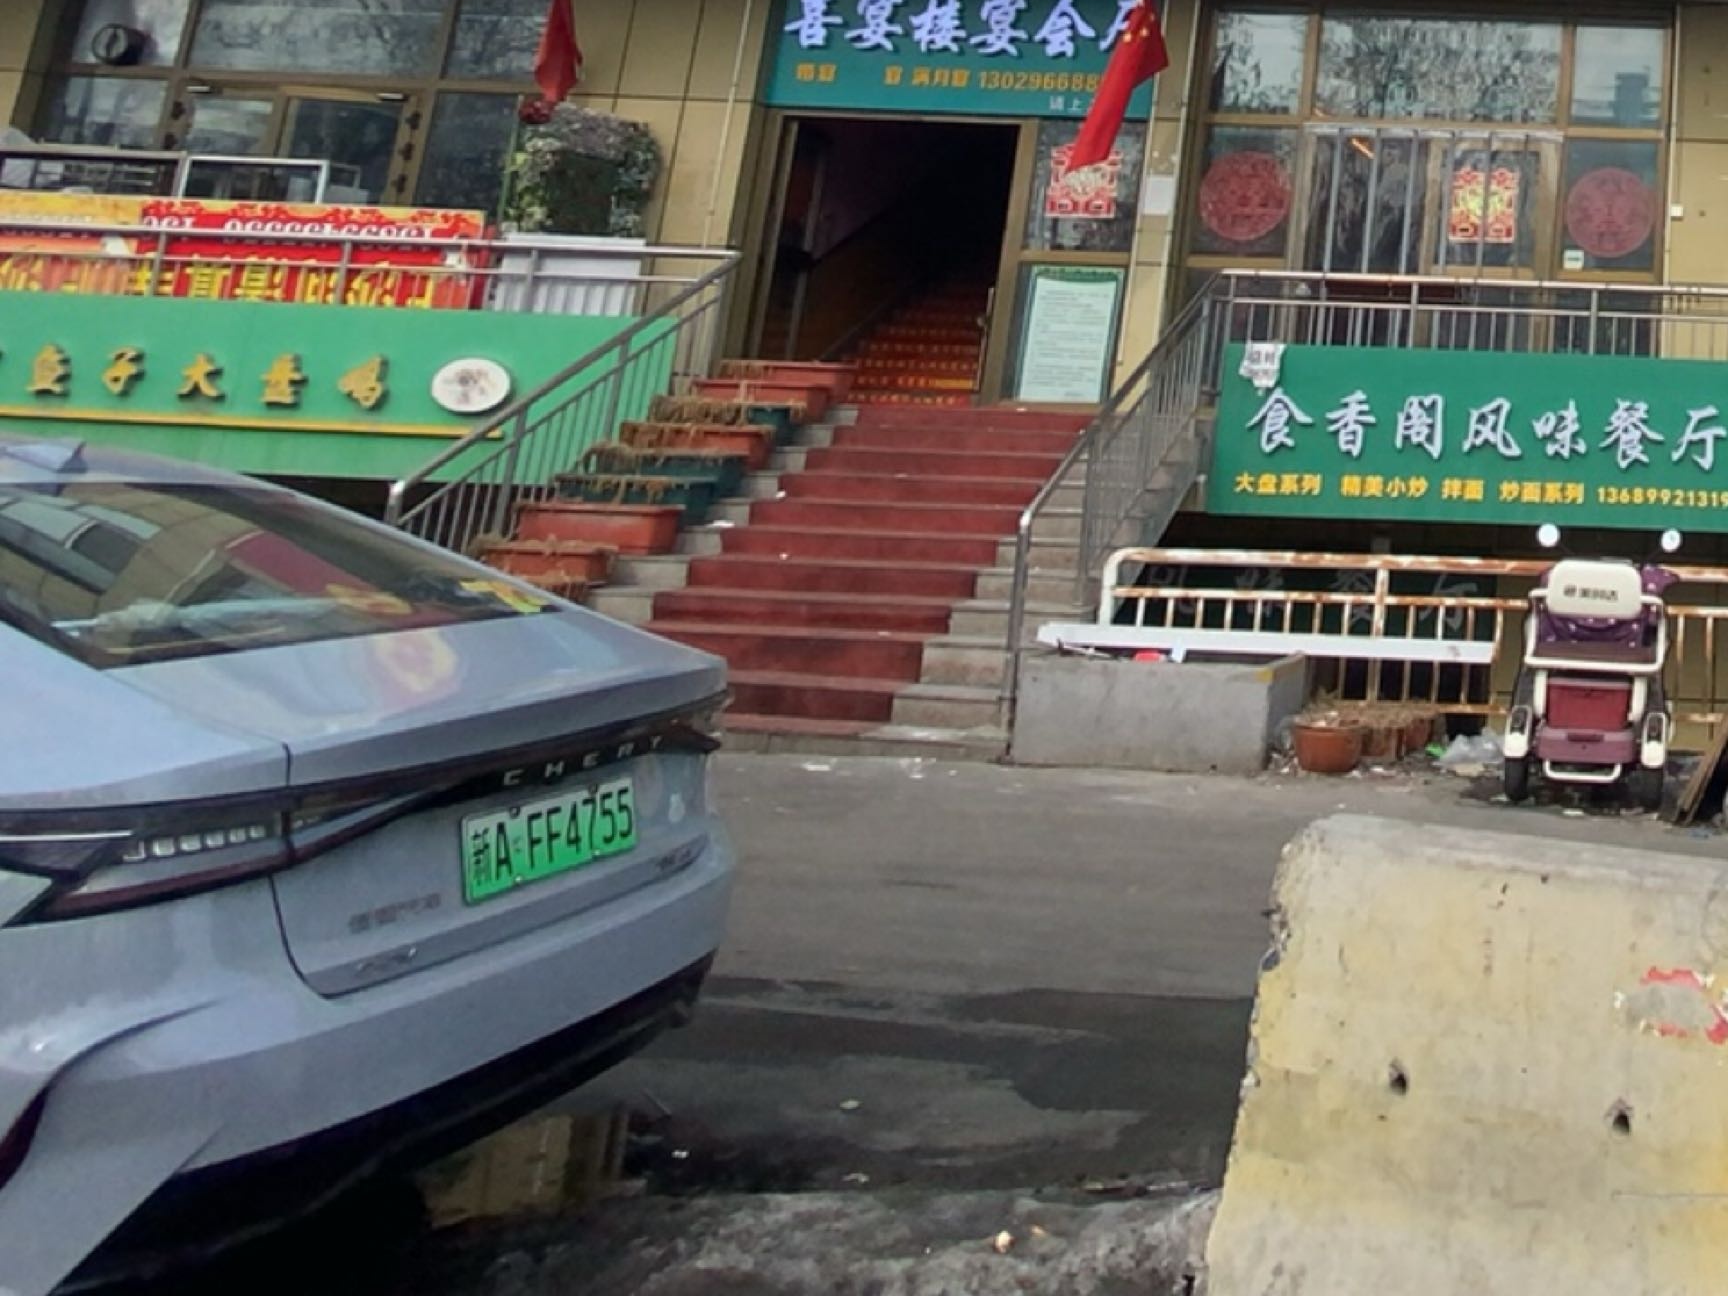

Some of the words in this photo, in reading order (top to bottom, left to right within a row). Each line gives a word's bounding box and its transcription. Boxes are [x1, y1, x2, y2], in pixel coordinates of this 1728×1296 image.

[979, 70, 1104, 93] 130296688
[1246, 387, 1728, 472] 食香阁风味餐厅
[1234, 472, 1323, 497] 大盘系列
[1339, 475, 1429, 499] 精美小炒
[1498, 479, 1586, 506] 炒面系列
[503, 735, 662, 787] CHERY
